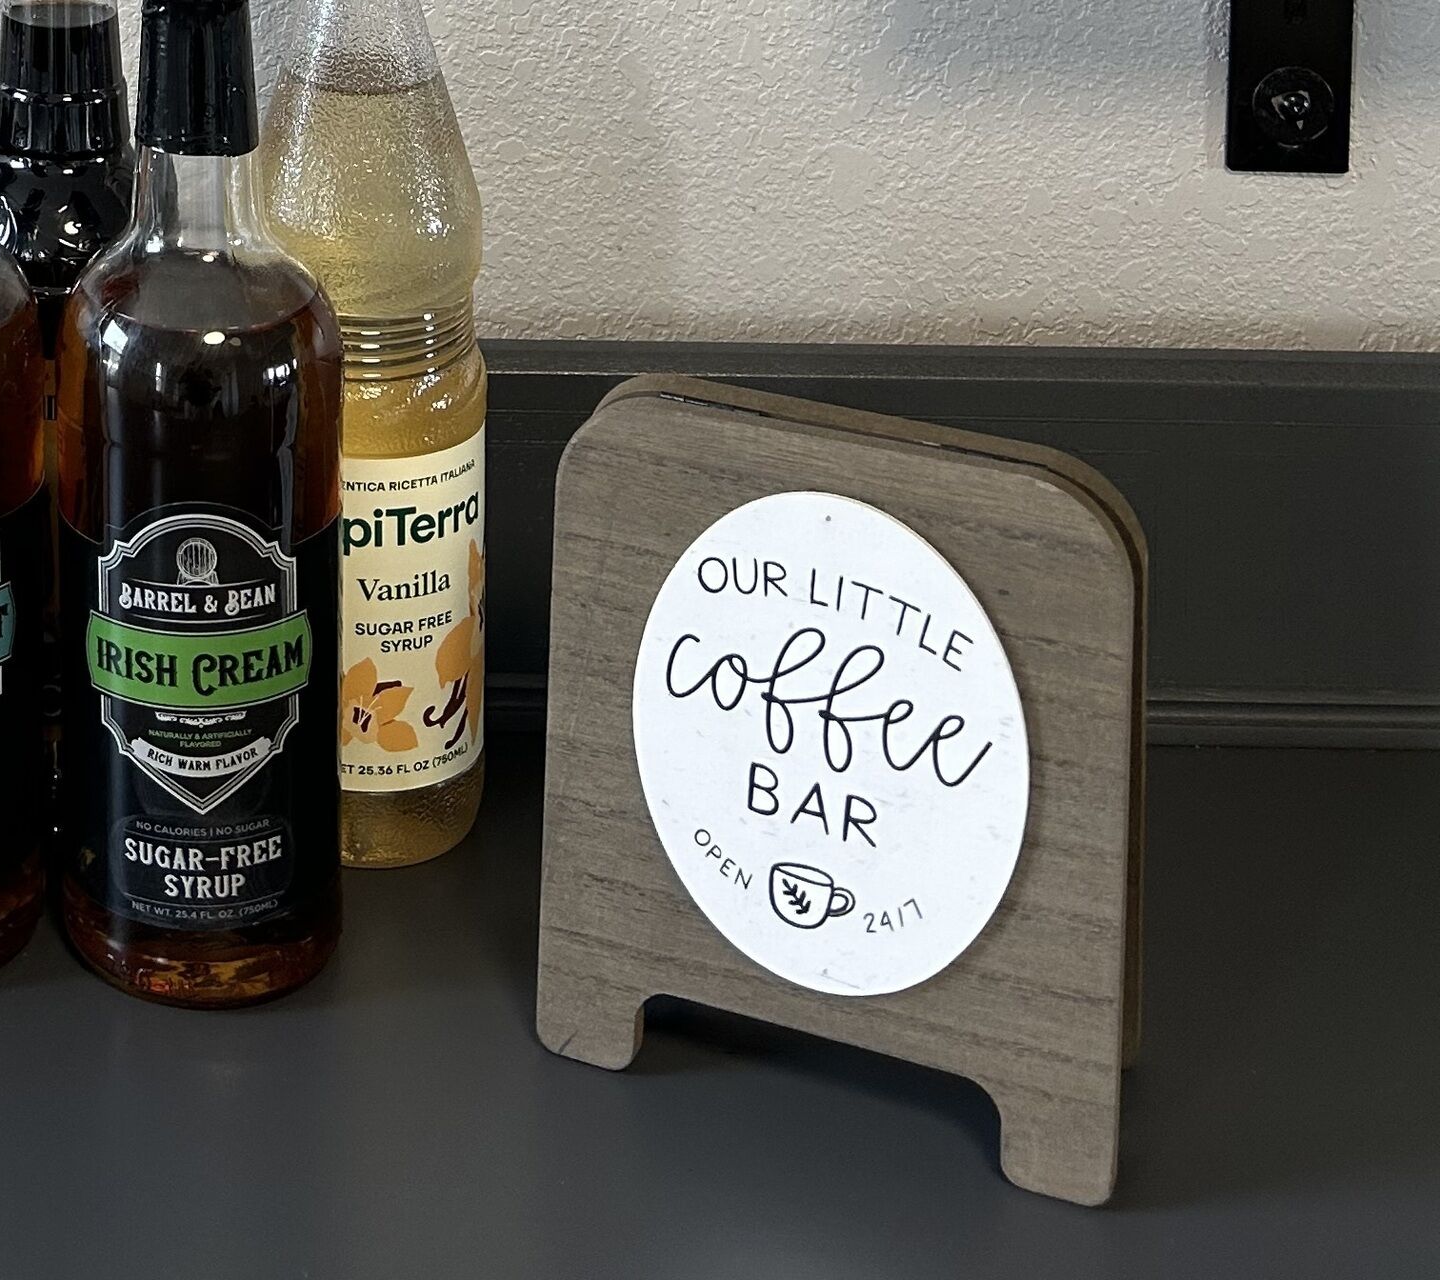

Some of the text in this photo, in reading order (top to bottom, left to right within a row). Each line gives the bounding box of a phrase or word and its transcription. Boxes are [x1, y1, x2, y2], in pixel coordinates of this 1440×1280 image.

[389, 475, 438, 491] RICETTA
[441, 459, 475, 482] ITALIANA
[343, 491, 479, 556] piTerra
[118, 582, 276, 616] BARREL & BEAN
[356, 570, 451, 601] Vanilla
[355, 610, 452, 635] SUGAR FREE
[697, 556, 973, 671] OUR LITTLE
[381, 635, 433, 653] SYRUP
[96, 634, 304, 696] IRISH CREAM
[666, 627, 992, 787] coffee
[148, 729, 193, 740] NATURALLY
[201, 729, 252, 740] ARTIFICIALLY
[147, 748, 258, 771] RICH WARM FLAVOR
[358, 765, 393, 775] 25.36
[397, 764, 410, 774] FL
[414, 760, 430, 771] OZ
[747, 762, 877, 847] BAR
[136, 821, 152, 831] NO
[154, 825, 207, 837] CALORIES
[215, 826, 233, 836] NO
[235, 819, 270, 834] SUGAR
[125, 835, 282, 871] SUGAR-FREE
[164, 873, 246, 899] SYRUP
[694, 828, 923, 934] OPEN 24/7
[132, 901, 151, 912] NET
[175, 910, 197, 919] 25.4
